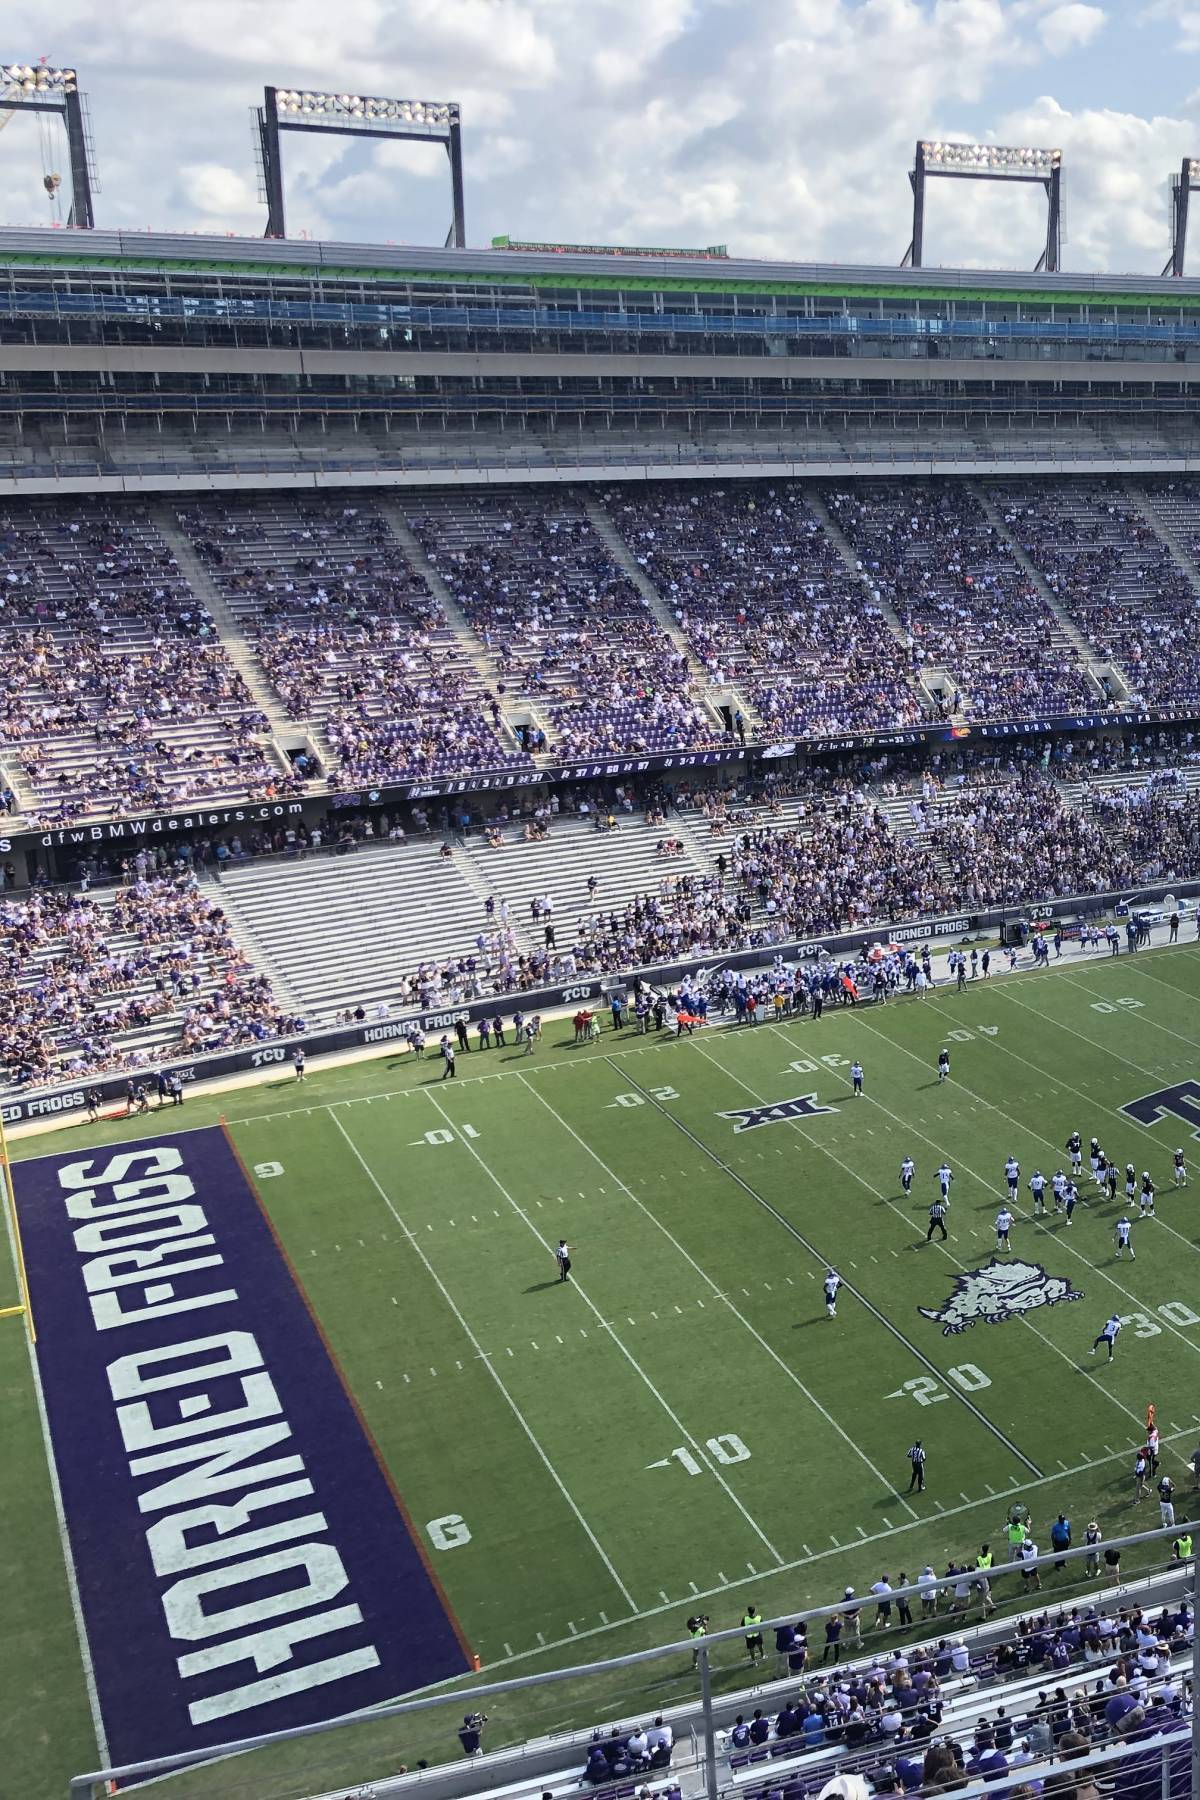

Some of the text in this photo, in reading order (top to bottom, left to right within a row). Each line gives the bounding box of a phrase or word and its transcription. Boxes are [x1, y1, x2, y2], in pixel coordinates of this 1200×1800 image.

[41, 801, 303, 847] dfwBMWdealers.com
[1031, 906, 1053, 920] TCU
[889, 920, 969, 944] HORNED FROGS
[562, 985, 591, 1001] TCU
[1090, 997, 1147, 1015] 50
[425, 1010, 470, 1031] FROGS
[946, 1024, 1000, 1042] 40
[251, 1048, 285, 1067] TCU
[787, 1053, 851, 1073] 30
[27, 1091, 85, 1113] FROGS
[614, 1085, 681, 1107] 20
[423, 1123, 481, 1146] 10
[57, 1146, 239, 1331] FROGS
[1121, 1301, 1200, 1338] 30
[902, 1363, 993, 1407] 20
[671, 1432, 752, 1476] 10
[106, 1330, 382, 1726] HORNED
[425, 1513, 473, 1550] G
[1053, 1645, 1067, 1658] 43
[929, 1703, 937, 1715] 5
